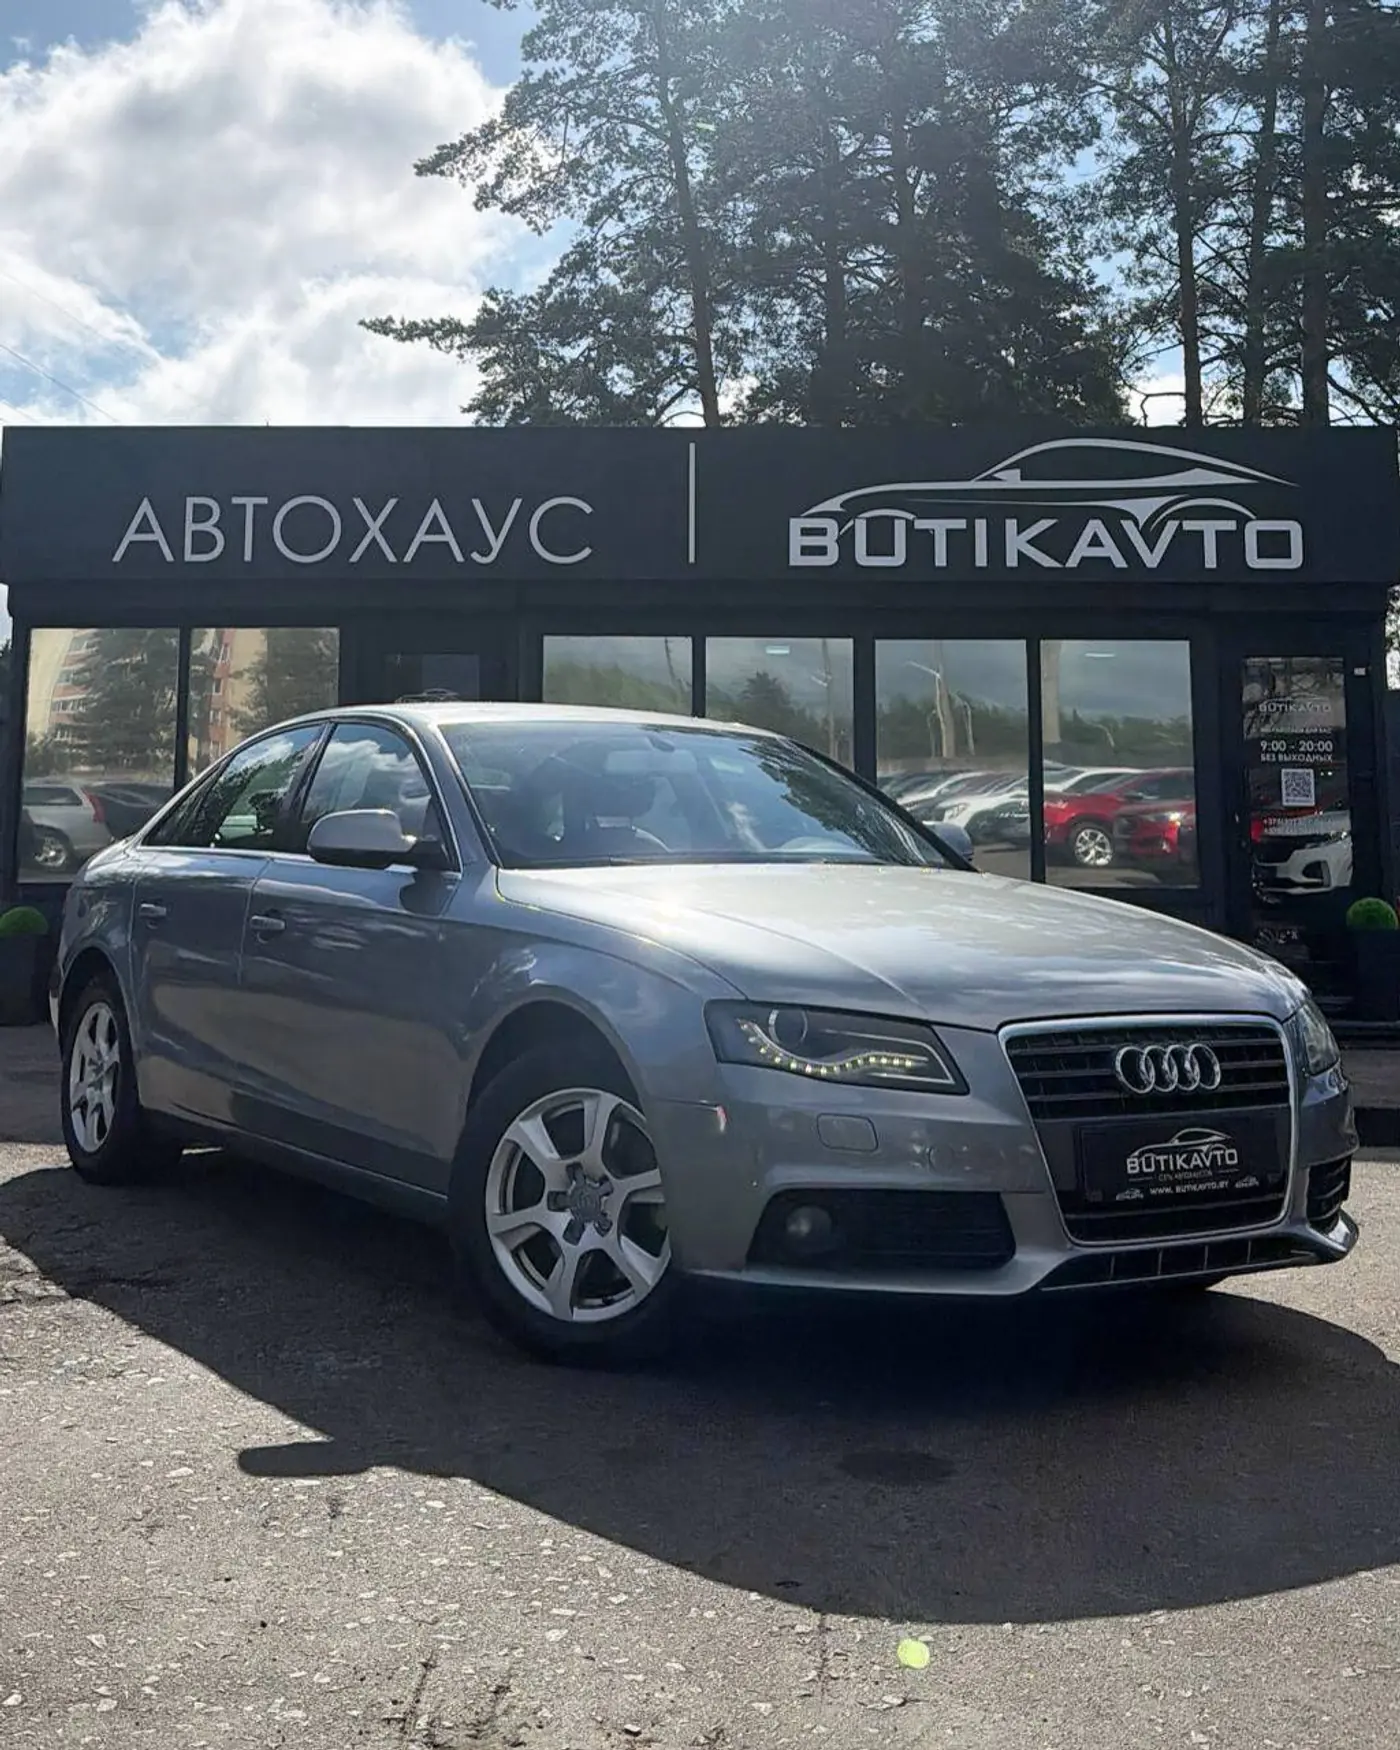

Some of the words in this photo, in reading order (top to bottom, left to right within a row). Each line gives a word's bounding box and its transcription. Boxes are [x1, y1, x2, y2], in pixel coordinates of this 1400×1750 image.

[112, 495, 595, 564] АВТОХАУС
[788, 517, 1303, 570] BUTIKAVTO
[1258, 702, 1332, 712] BUTIKAVTO
[1260, 740, 1287, 752] 9:00
[1298, 740, 1333, 752] 20:00
[1260, 753, 1276, 762] БЕЗ
[1278, 753, 1333, 763] ВЫХОДНЫХ
[1126, 1149, 1239, 1174] BUTIKAVTO
